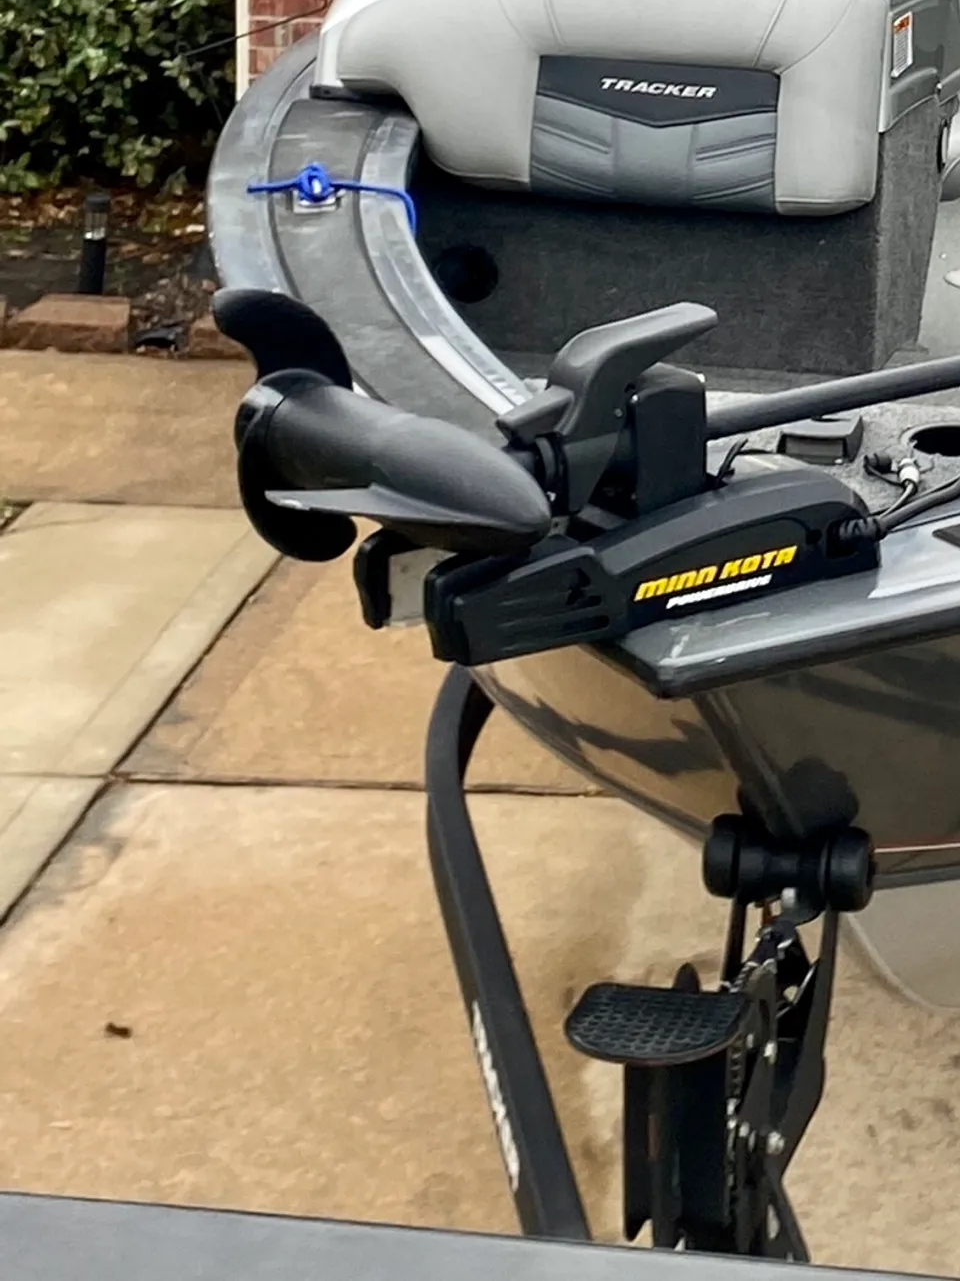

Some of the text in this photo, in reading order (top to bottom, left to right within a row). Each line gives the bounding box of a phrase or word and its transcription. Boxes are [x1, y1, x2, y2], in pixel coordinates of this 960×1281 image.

[601, 77, 718, 98] TRACKER
[634, 545, 797, 602] MINN KOTA
